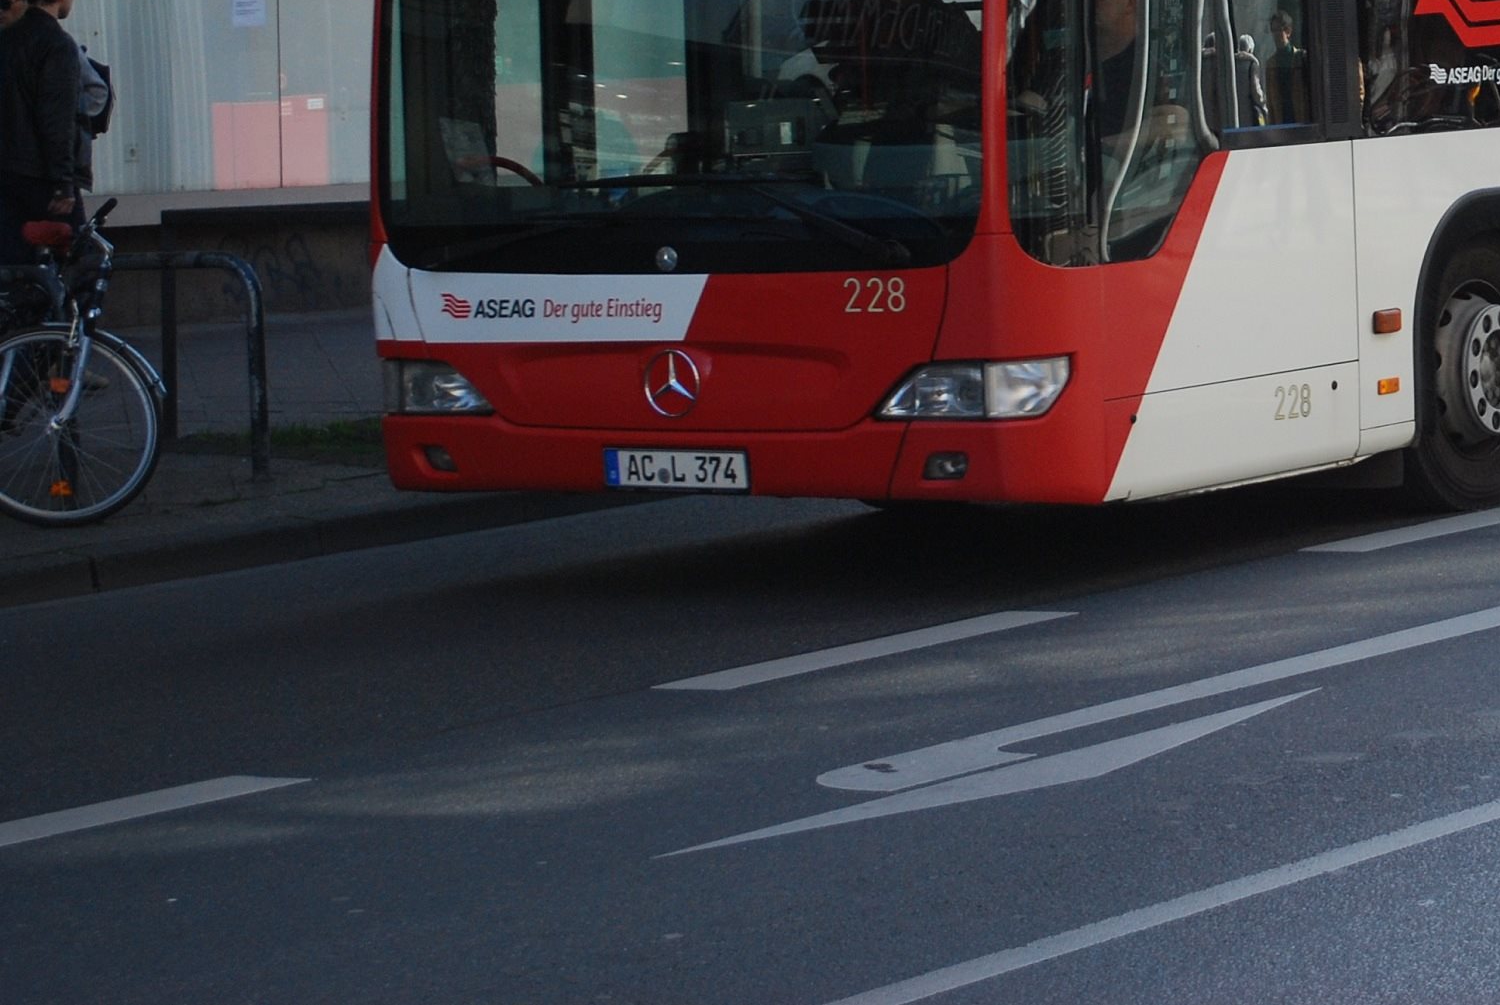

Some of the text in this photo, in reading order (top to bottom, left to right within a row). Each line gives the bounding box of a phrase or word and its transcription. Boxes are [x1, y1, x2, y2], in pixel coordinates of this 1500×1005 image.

[1447, 66, 1481, 84] ASEAG
[1482, 65, 1496, 81] Der
[843, 277, 906, 313] 228
[474, 298, 663, 324] ASEAG Der gute Einstieg
[1274, 383, 1312, 421] 228
[627, 454, 738, 484] AC L 374
